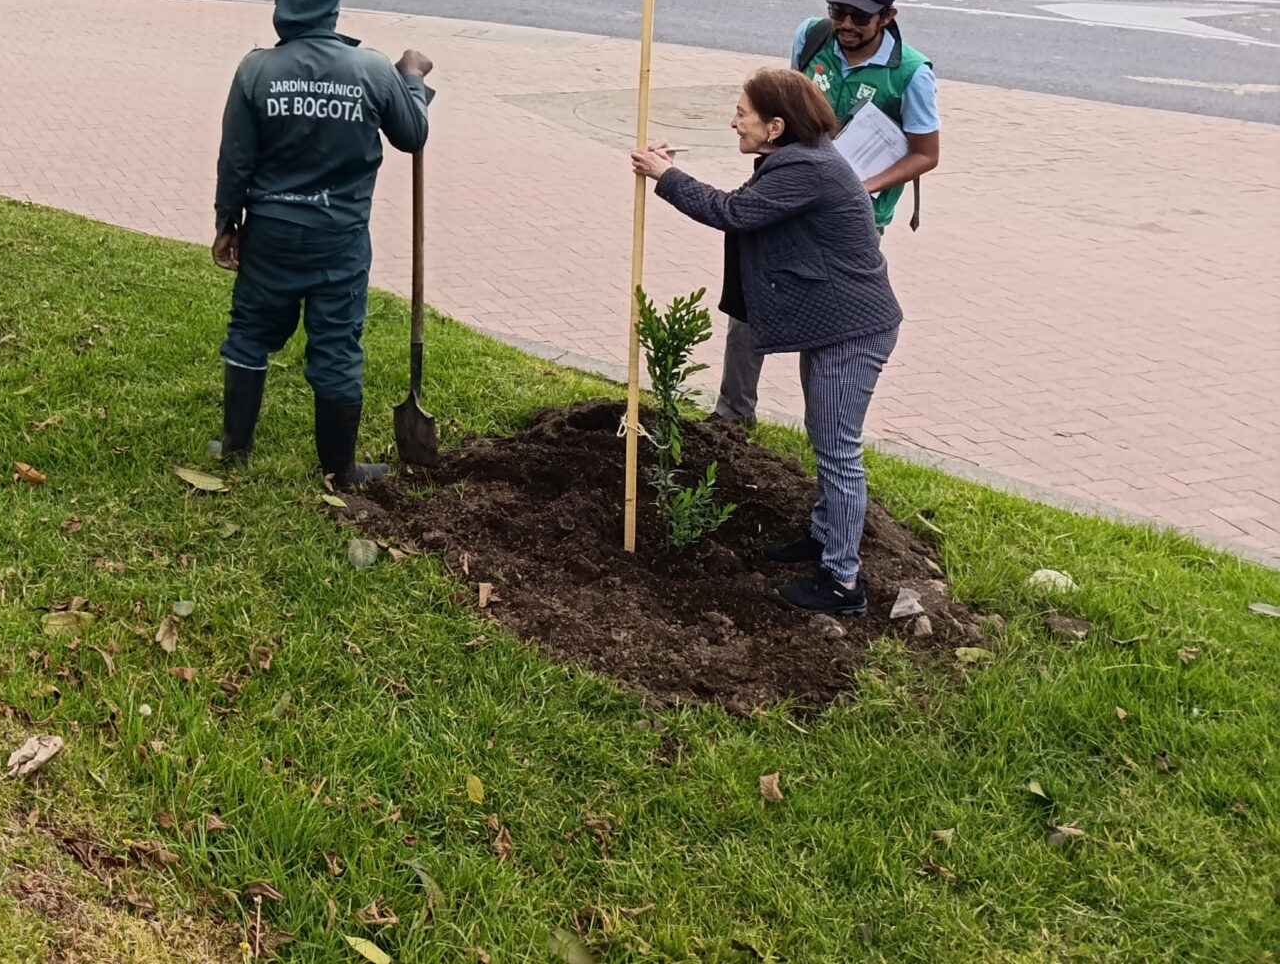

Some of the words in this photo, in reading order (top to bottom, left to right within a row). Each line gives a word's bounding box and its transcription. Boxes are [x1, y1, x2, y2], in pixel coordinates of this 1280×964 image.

[269, 77, 308, 94] JARDÍN
[309, 79, 363, 98] BOTÁNICO
[266, 97, 290, 117] DE
[293, 96, 364, 123] BOGOTÁ
